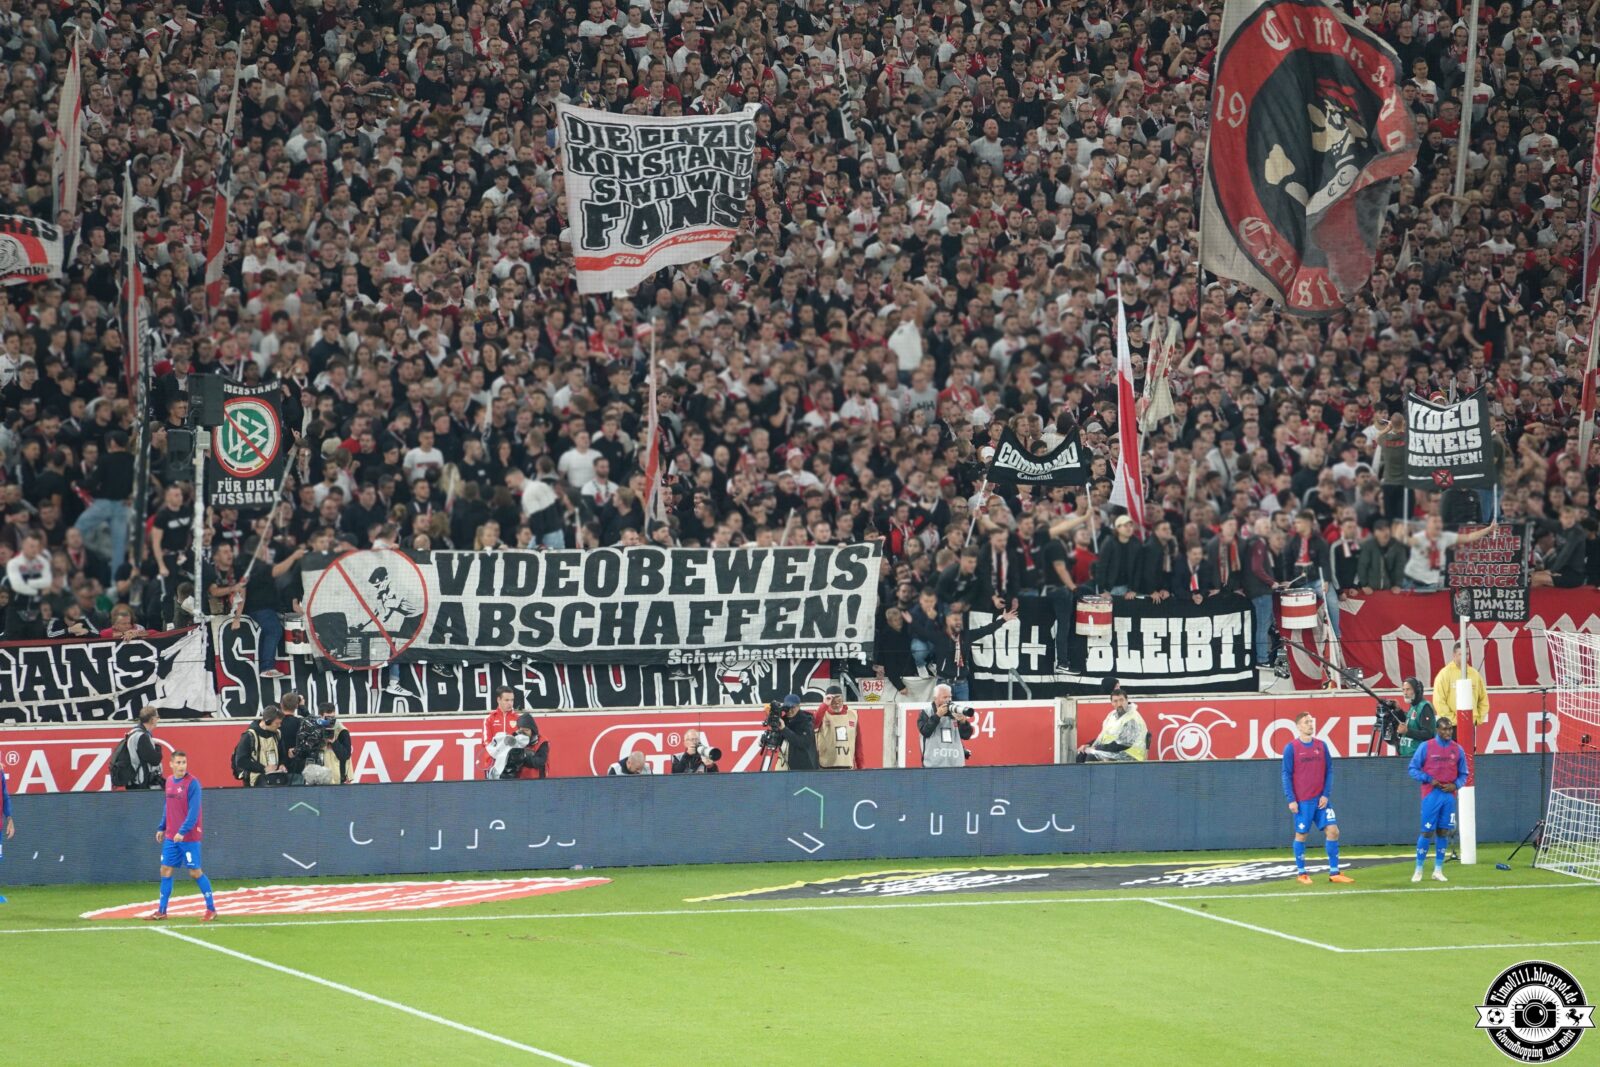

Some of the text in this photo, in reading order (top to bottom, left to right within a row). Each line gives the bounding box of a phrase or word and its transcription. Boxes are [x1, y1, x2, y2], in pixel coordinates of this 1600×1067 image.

[564, 113, 631, 152] DIE
[567, 145, 752, 180] KONSTANT
[592, 170, 750, 206] SIND WIR
[582, 190, 746, 250] FANS
[1407, 398, 1480, 431] VIDEO
[1408, 427, 1482, 454] BEWEIS
[211, 491, 282, 506] FUSSBALL
[217, 477, 275, 493] FÜR DEN
[435, 543, 870, 597] VIDEOBEWEIS
[1473, 588, 1526, 599] DU BIST
[1473, 599, 1525, 611] IMMER
[428, 594, 862, 648] ABSCHAFFEN!
[1474, 610, 1526, 620] BEI UNS!
[668, 642, 863, 666] Schwabensturm02
[1086, 610, 1253, 673] BLEIBT!
[835, 746, 850, 756] TV
[933, 748, 960, 759] FOTO
